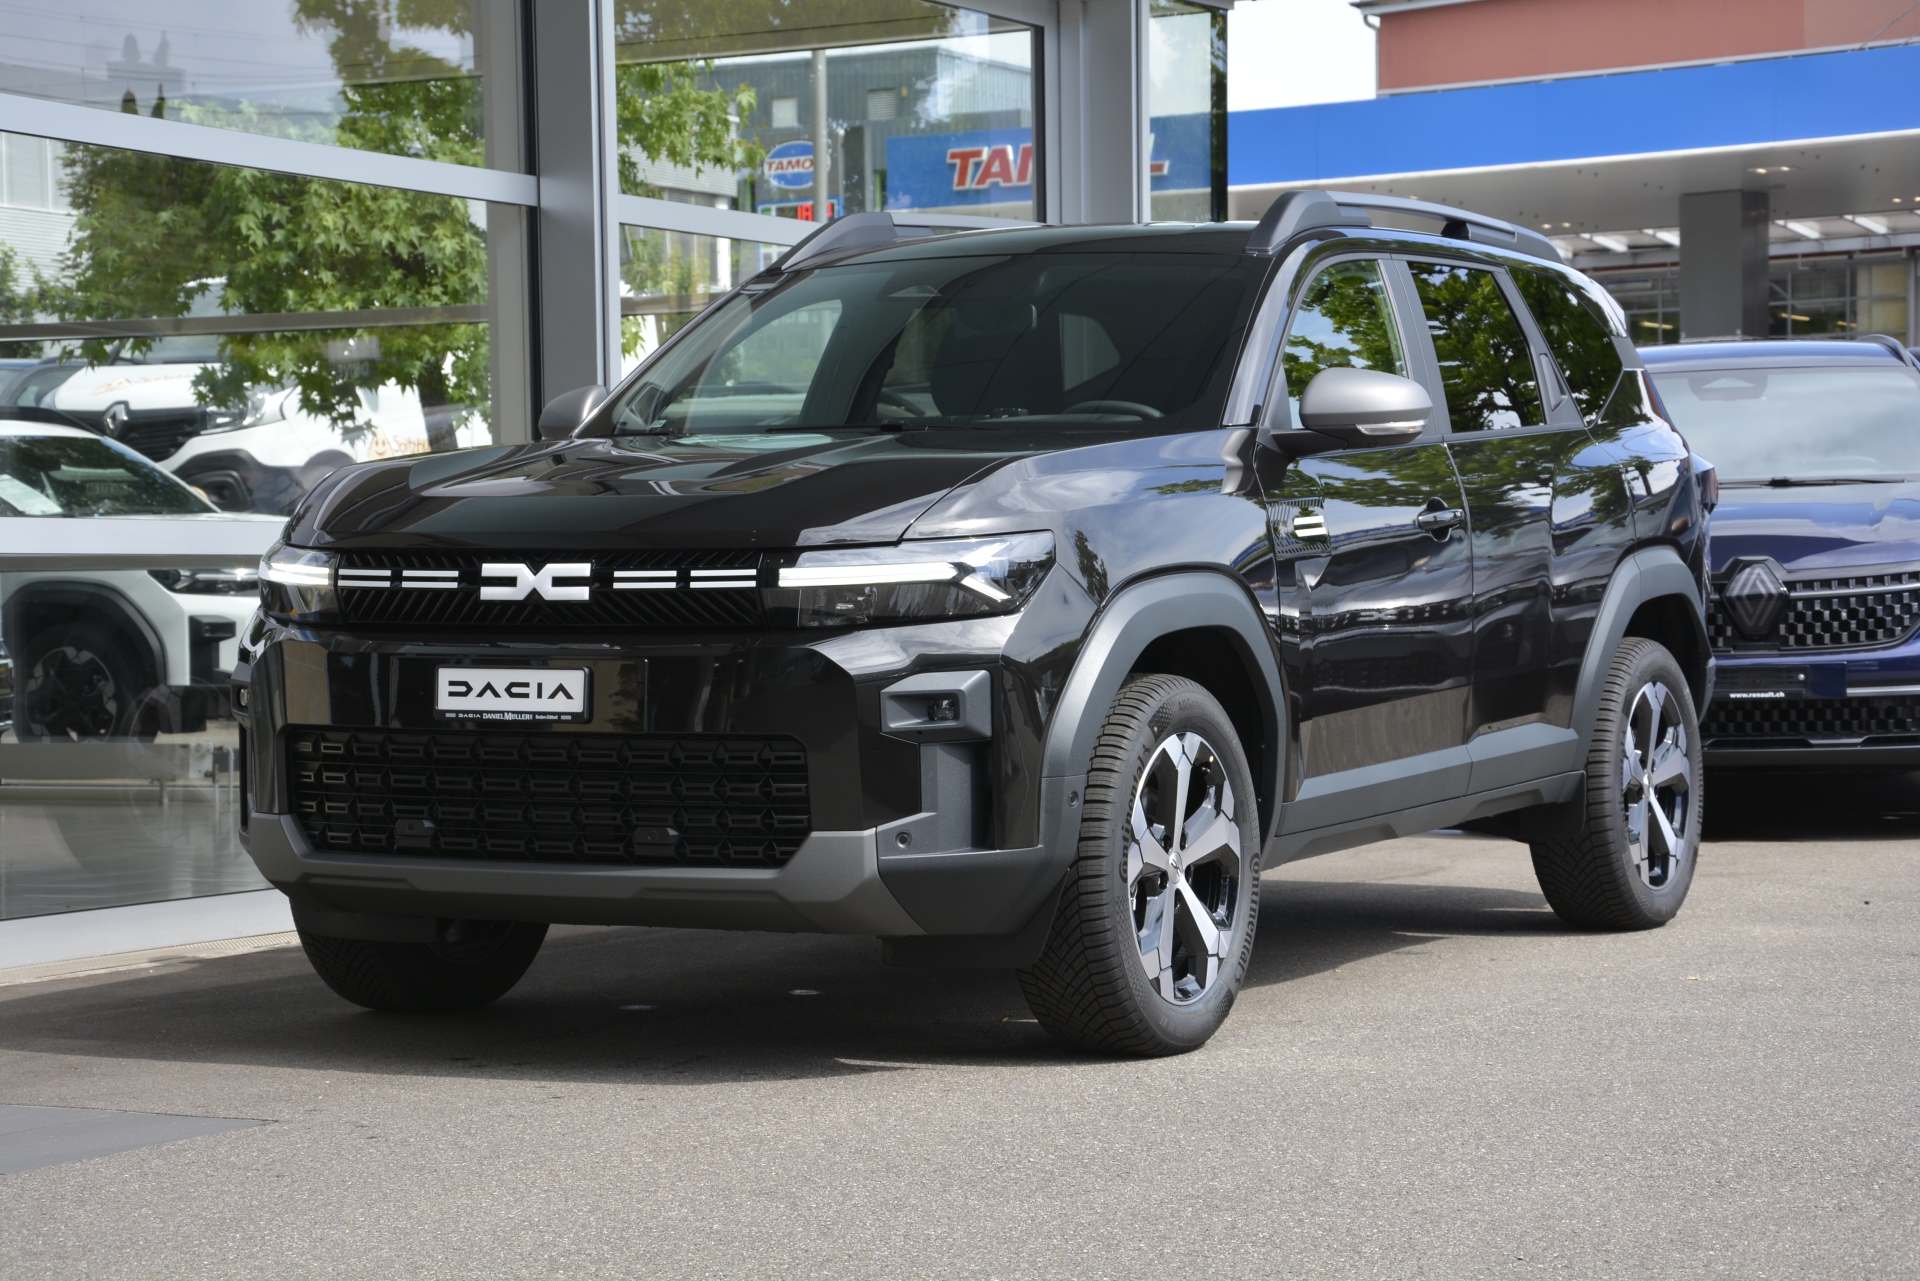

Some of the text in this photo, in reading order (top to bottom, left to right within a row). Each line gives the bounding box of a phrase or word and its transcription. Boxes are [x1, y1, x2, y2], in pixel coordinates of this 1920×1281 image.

[766, 157, 814, 172] TAMO
[448, 680, 575, 700] DACIA
[1729, 691, 1786, 699] www.renault.ch
[1237, 852, 1261, 973] Continental
